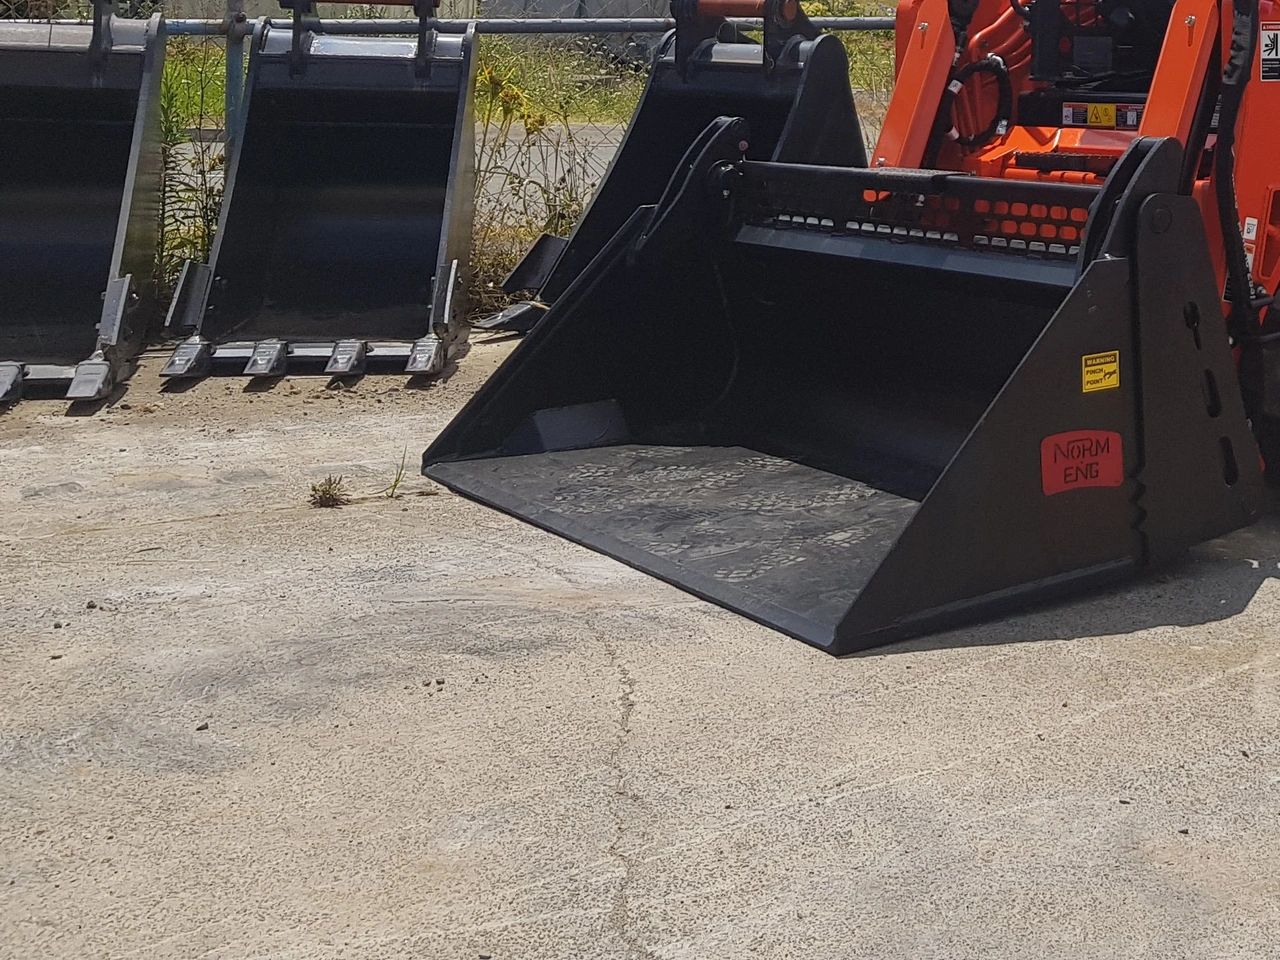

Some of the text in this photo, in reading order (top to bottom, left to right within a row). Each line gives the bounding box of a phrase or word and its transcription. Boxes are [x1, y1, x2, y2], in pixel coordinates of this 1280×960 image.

[1086, 355, 1115, 366] WARNING
[1086, 368, 1104, 376] PINCH
[1086, 378, 1104, 386] POINT
[1053, 437, 1111, 464] NORM
[1063, 462, 1100, 484] ENG
